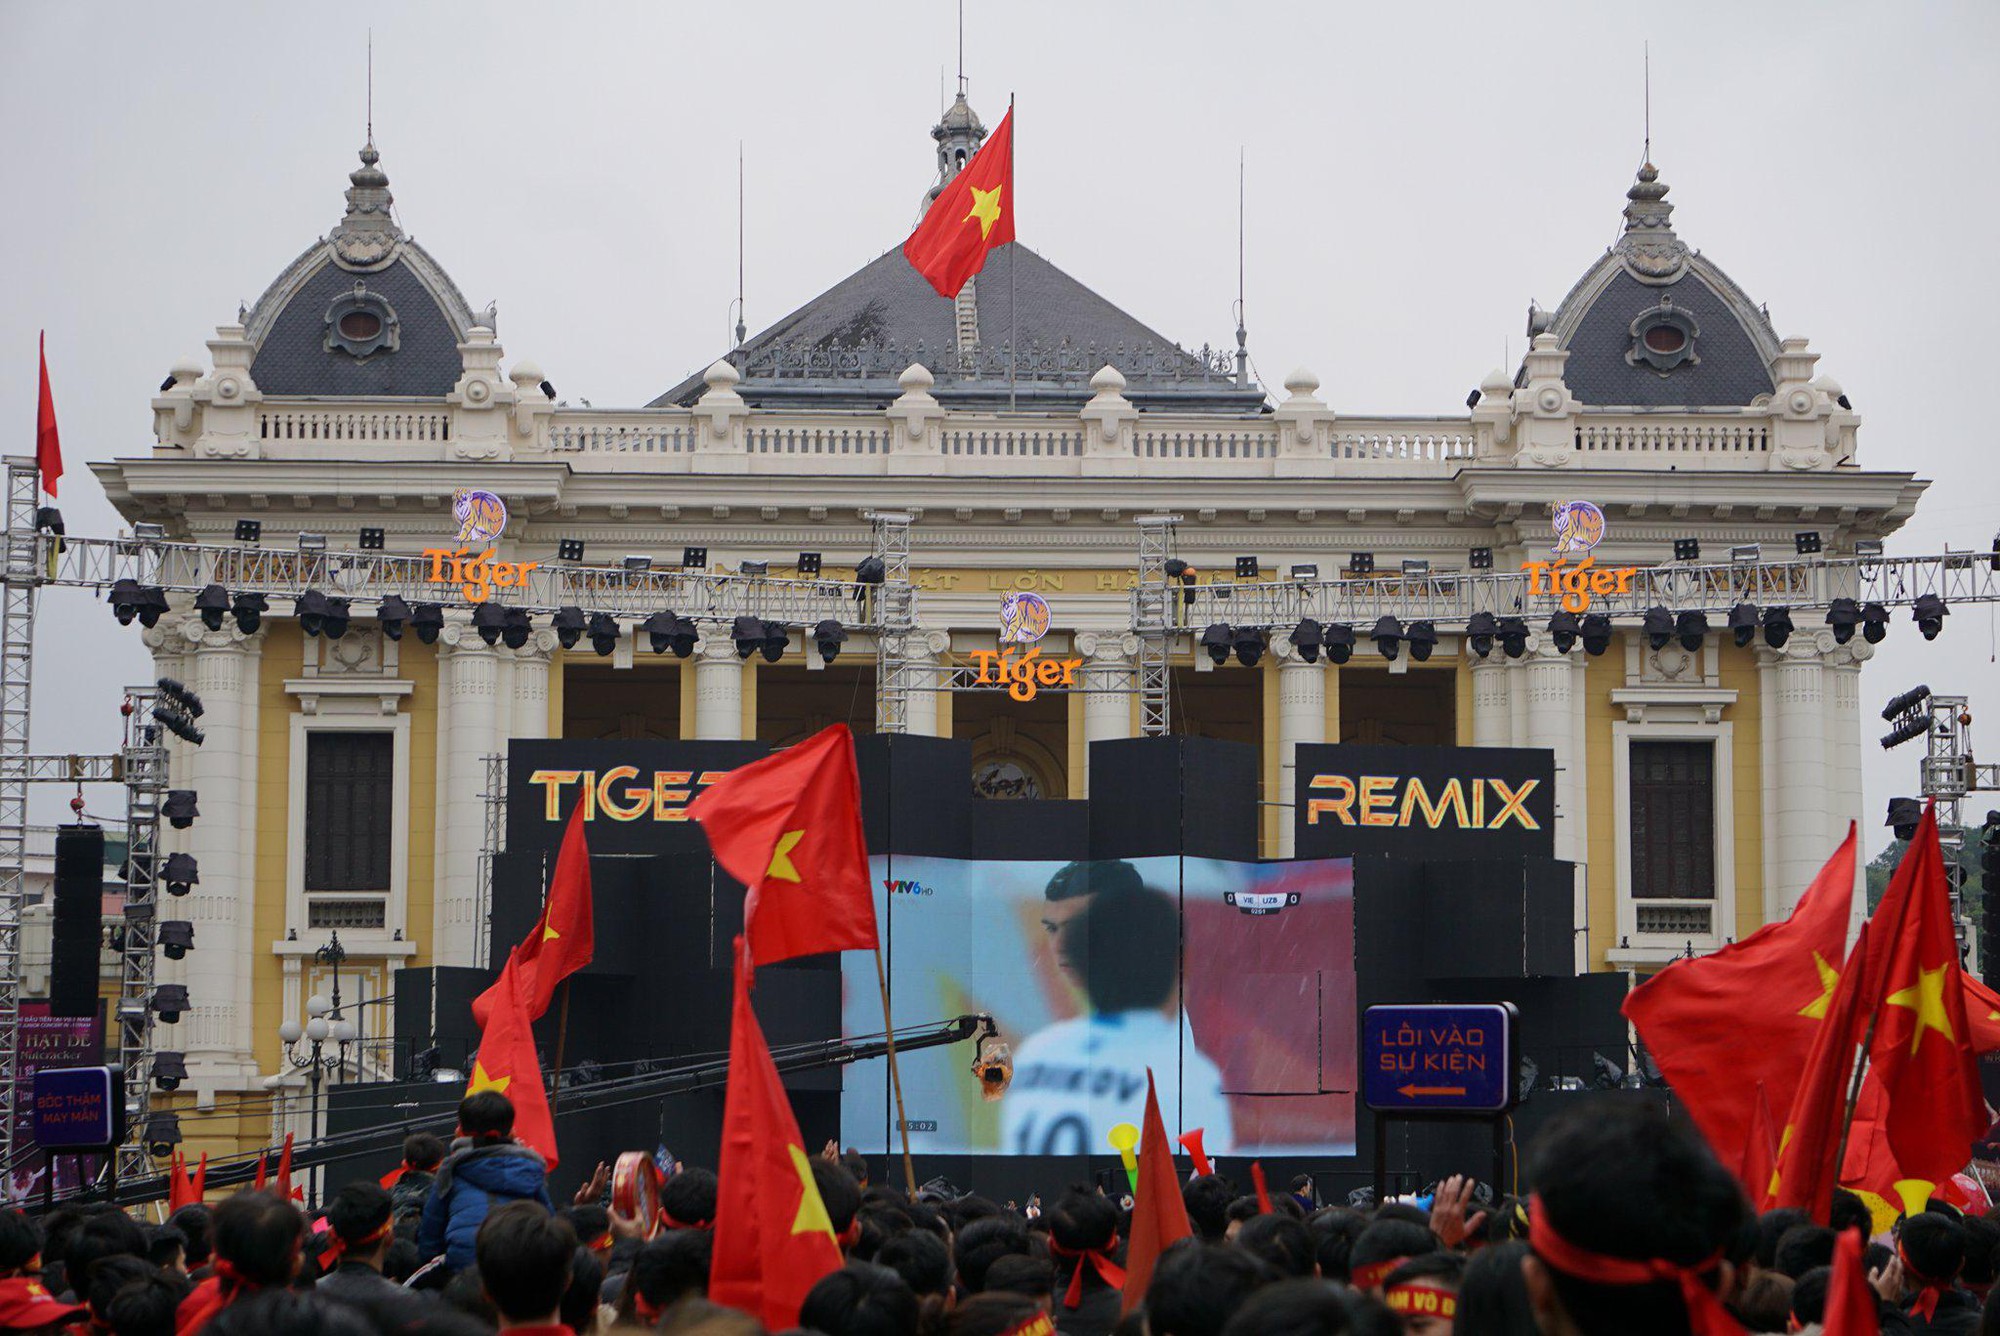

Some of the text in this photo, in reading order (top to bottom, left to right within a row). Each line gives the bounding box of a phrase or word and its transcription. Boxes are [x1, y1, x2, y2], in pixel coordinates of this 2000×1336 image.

[422, 546, 537, 603] Tiger
[1520, 556, 1637, 613] Tiger
[970, 647, 1082, 702] Tiger
[528, 765, 735, 821] TIGE
[1307, 774, 1541, 830] REMIX
[883, 880, 933, 896] VTV6 HD
[1424, 1048, 1485, 1074] KIỆN
[1430, 1024, 1484, 1046] VÀO
